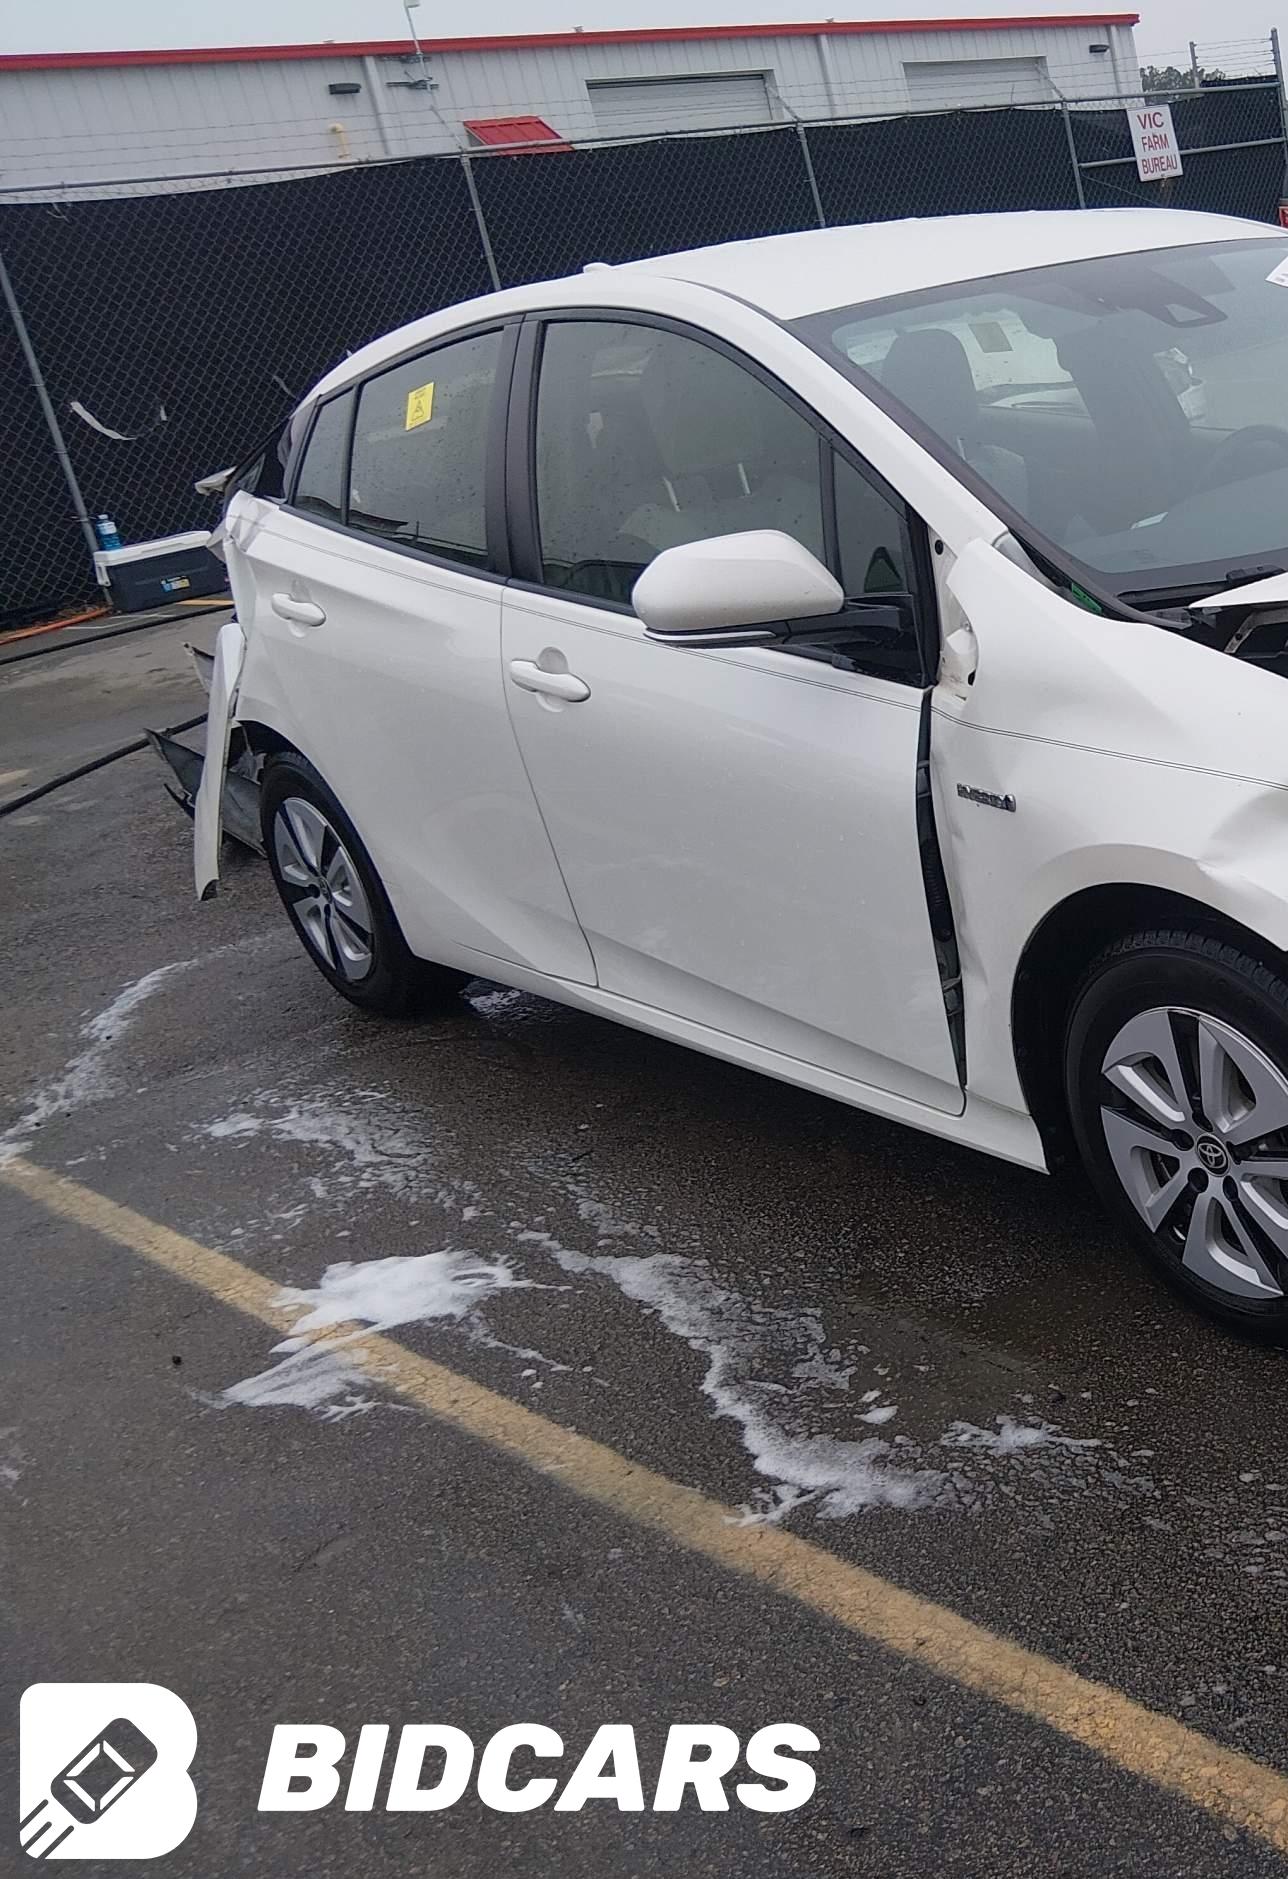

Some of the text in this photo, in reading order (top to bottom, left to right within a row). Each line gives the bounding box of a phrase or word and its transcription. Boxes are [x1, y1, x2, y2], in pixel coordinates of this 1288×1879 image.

[1137, 111, 1165, 130] VIC
[1141, 133, 1170, 153] FARM
[1141, 154, 1178, 175] BUREAU
